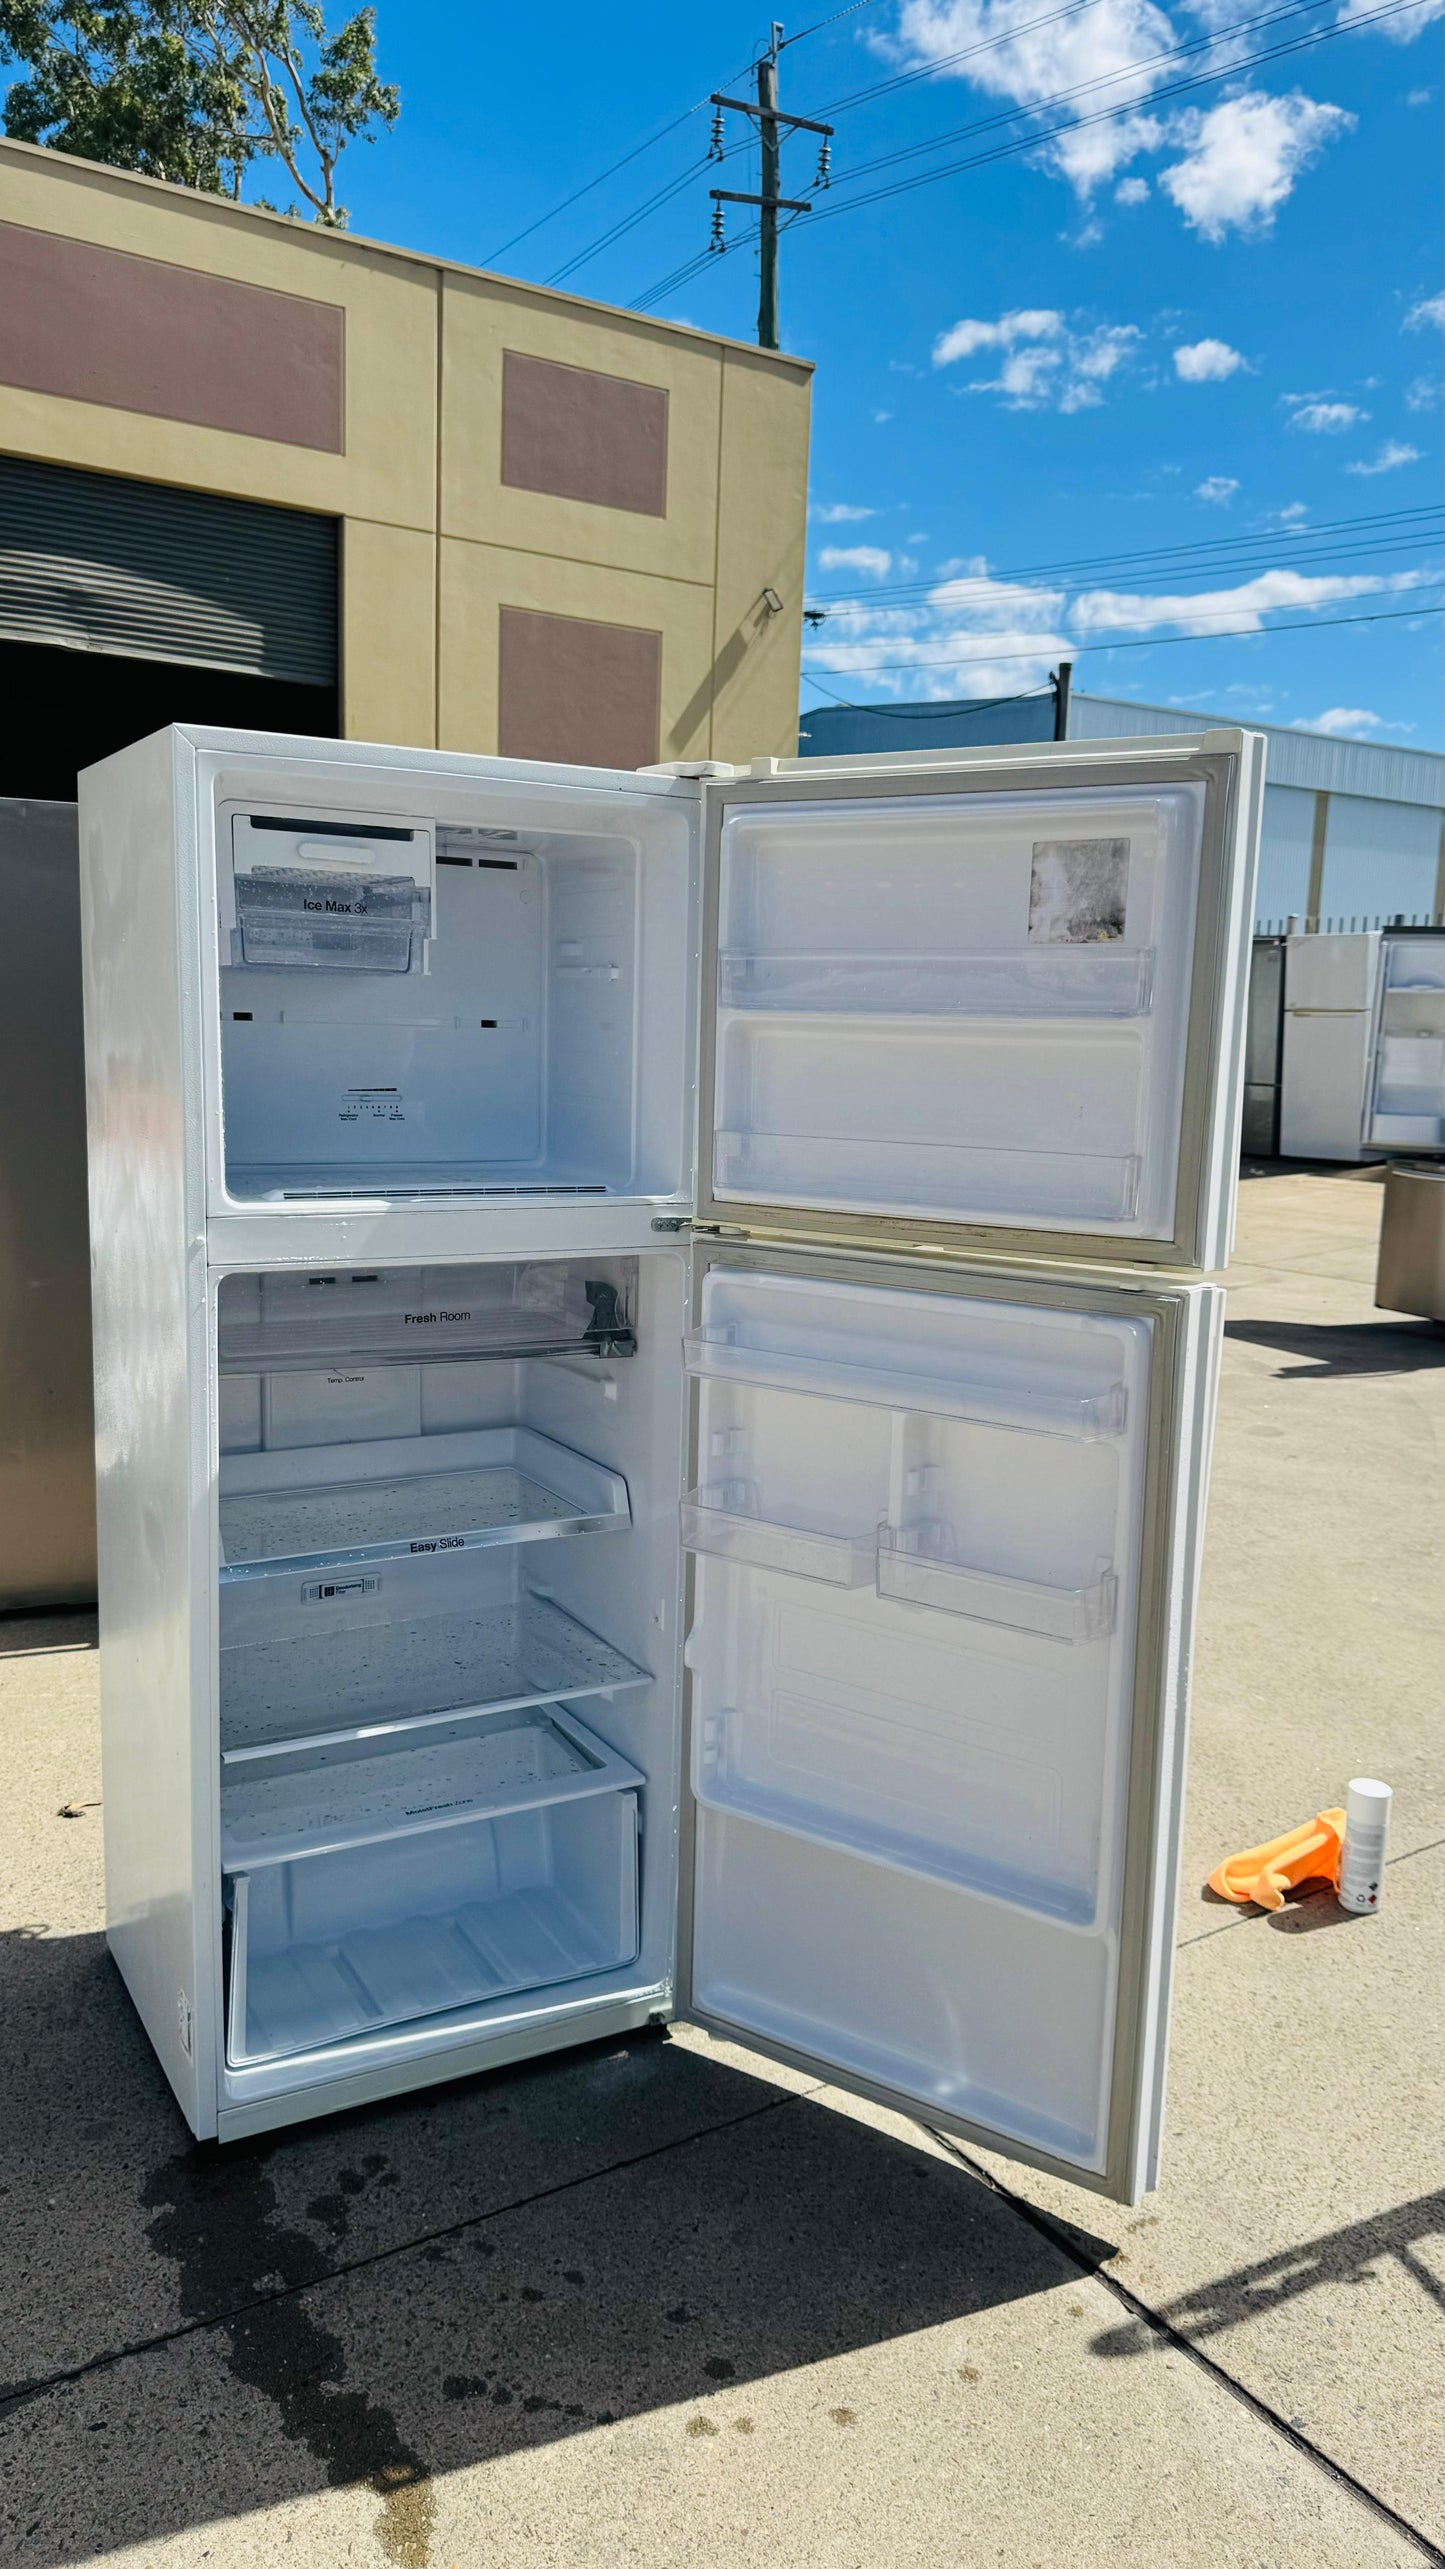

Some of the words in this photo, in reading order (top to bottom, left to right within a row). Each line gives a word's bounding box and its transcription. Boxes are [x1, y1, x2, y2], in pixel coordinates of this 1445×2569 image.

[303, 898, 322, 911] Ice
[325, 900, 352, 913] Max
[354, 902, 368, 914] 3x
[404, 1312, 437, 1324] Fresh
[440, 1311, 471, 1322] Room
[410, 1542, 437, 1553] Easy
[439, 1537, 465, 1549] Slide
